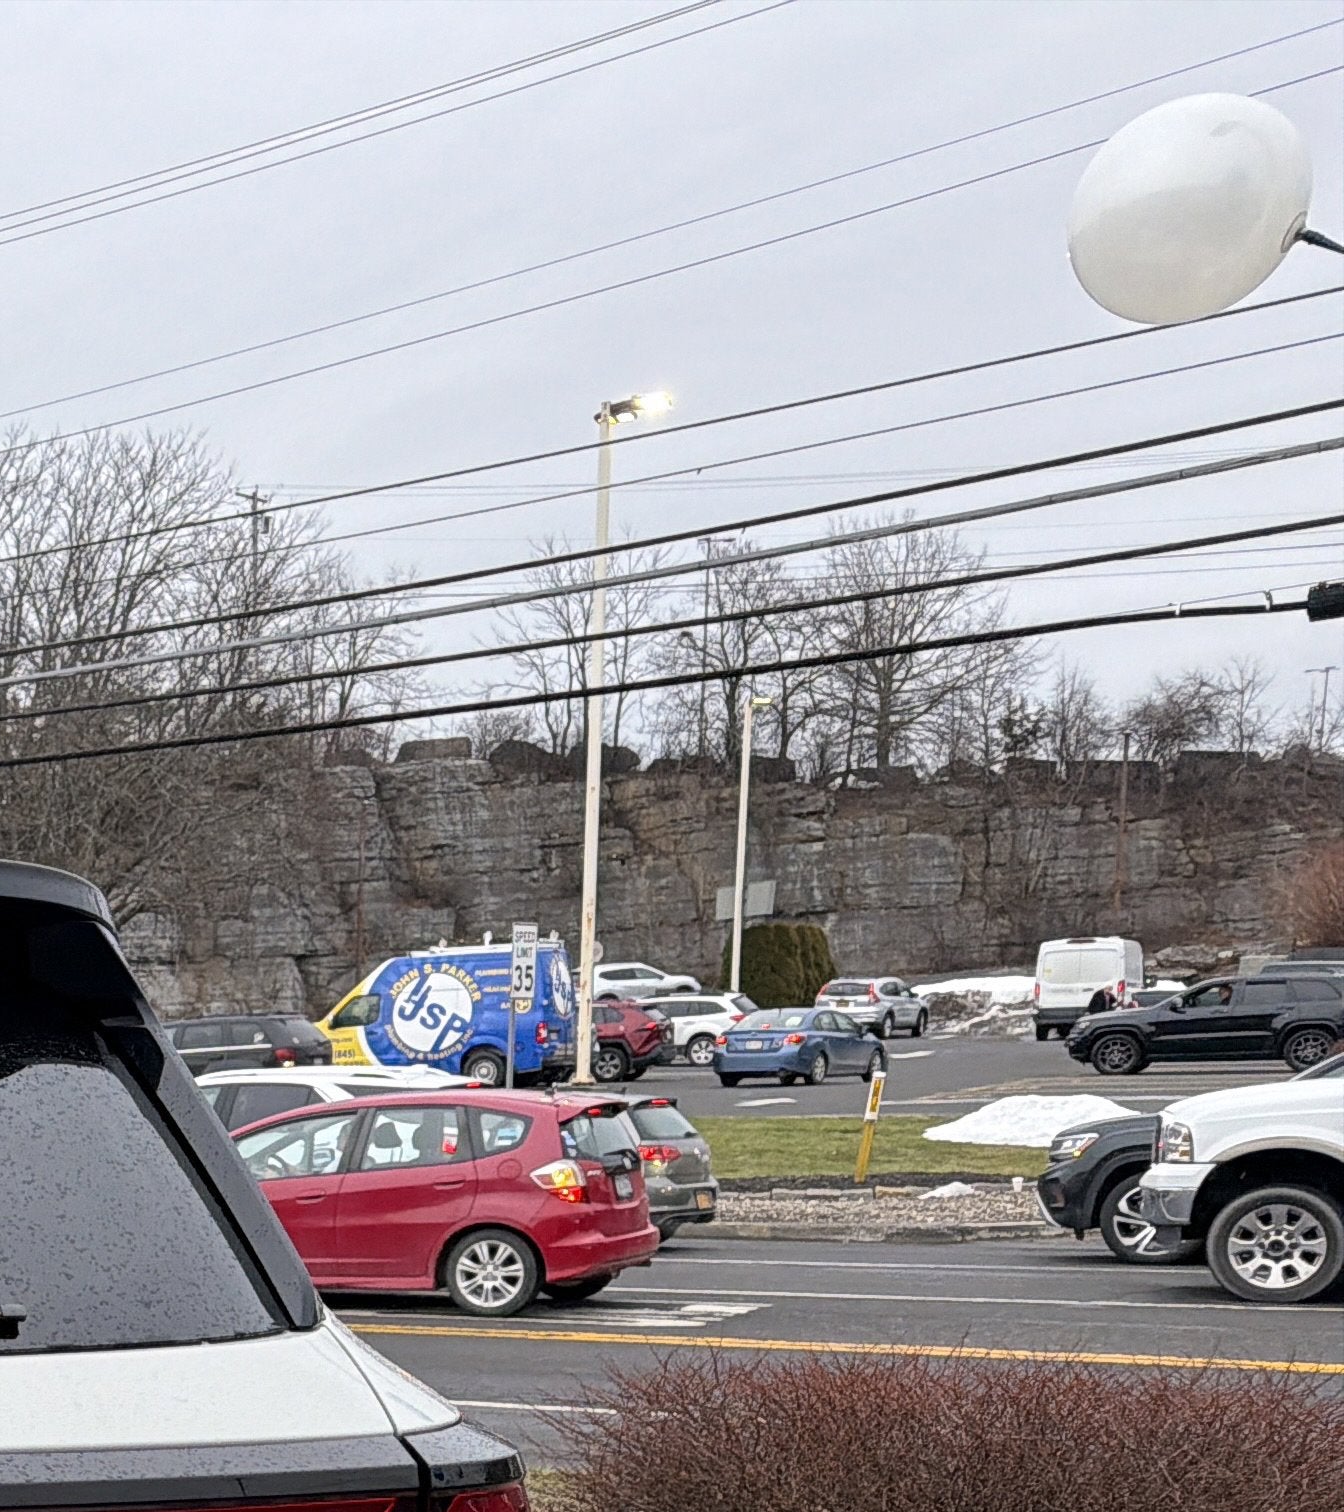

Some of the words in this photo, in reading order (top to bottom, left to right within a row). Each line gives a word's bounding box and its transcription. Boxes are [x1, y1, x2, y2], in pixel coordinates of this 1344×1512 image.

[390, 968, 420, 1000] JOHN
[440, 963, 482, 1002] PARKER
[514, 964, 534, 992] 35
